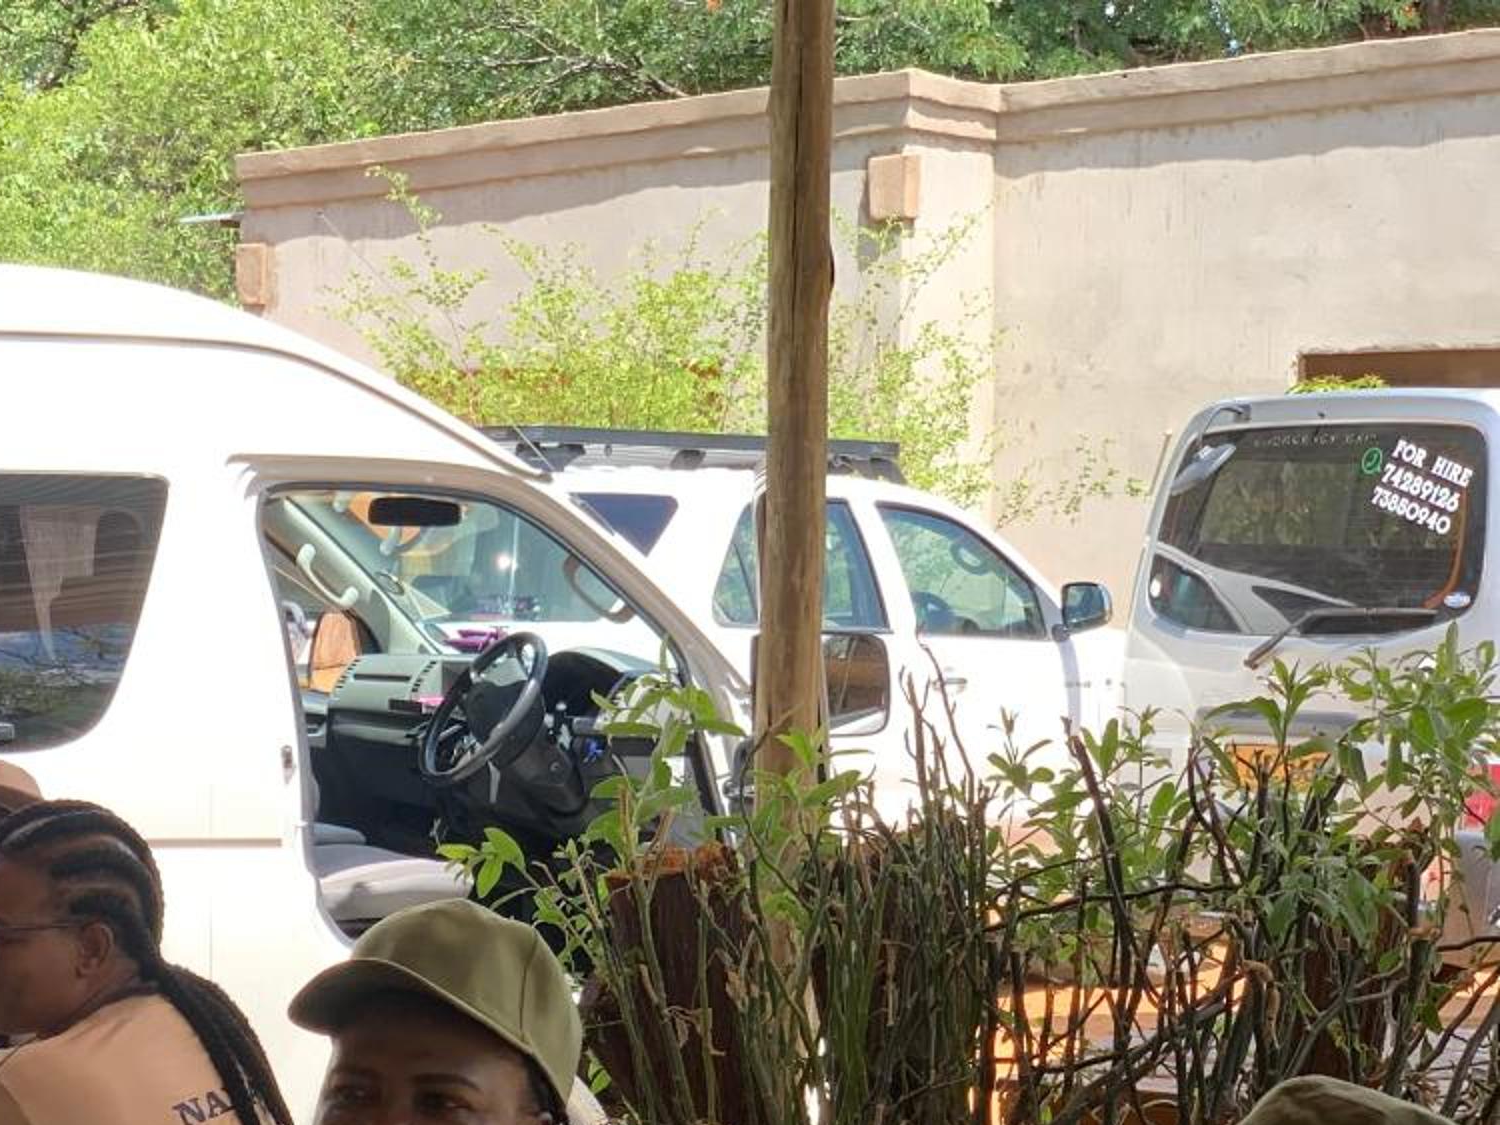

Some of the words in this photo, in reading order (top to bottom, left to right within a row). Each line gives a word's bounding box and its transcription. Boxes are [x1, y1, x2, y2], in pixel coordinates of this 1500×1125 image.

[1392, 439, 1427, 468] FOR
[1432, 456, 1473, 487] HIRE
[1371, 487, 1451, 535] 73850940
[1381, 463, 1460, 512] 74289126
